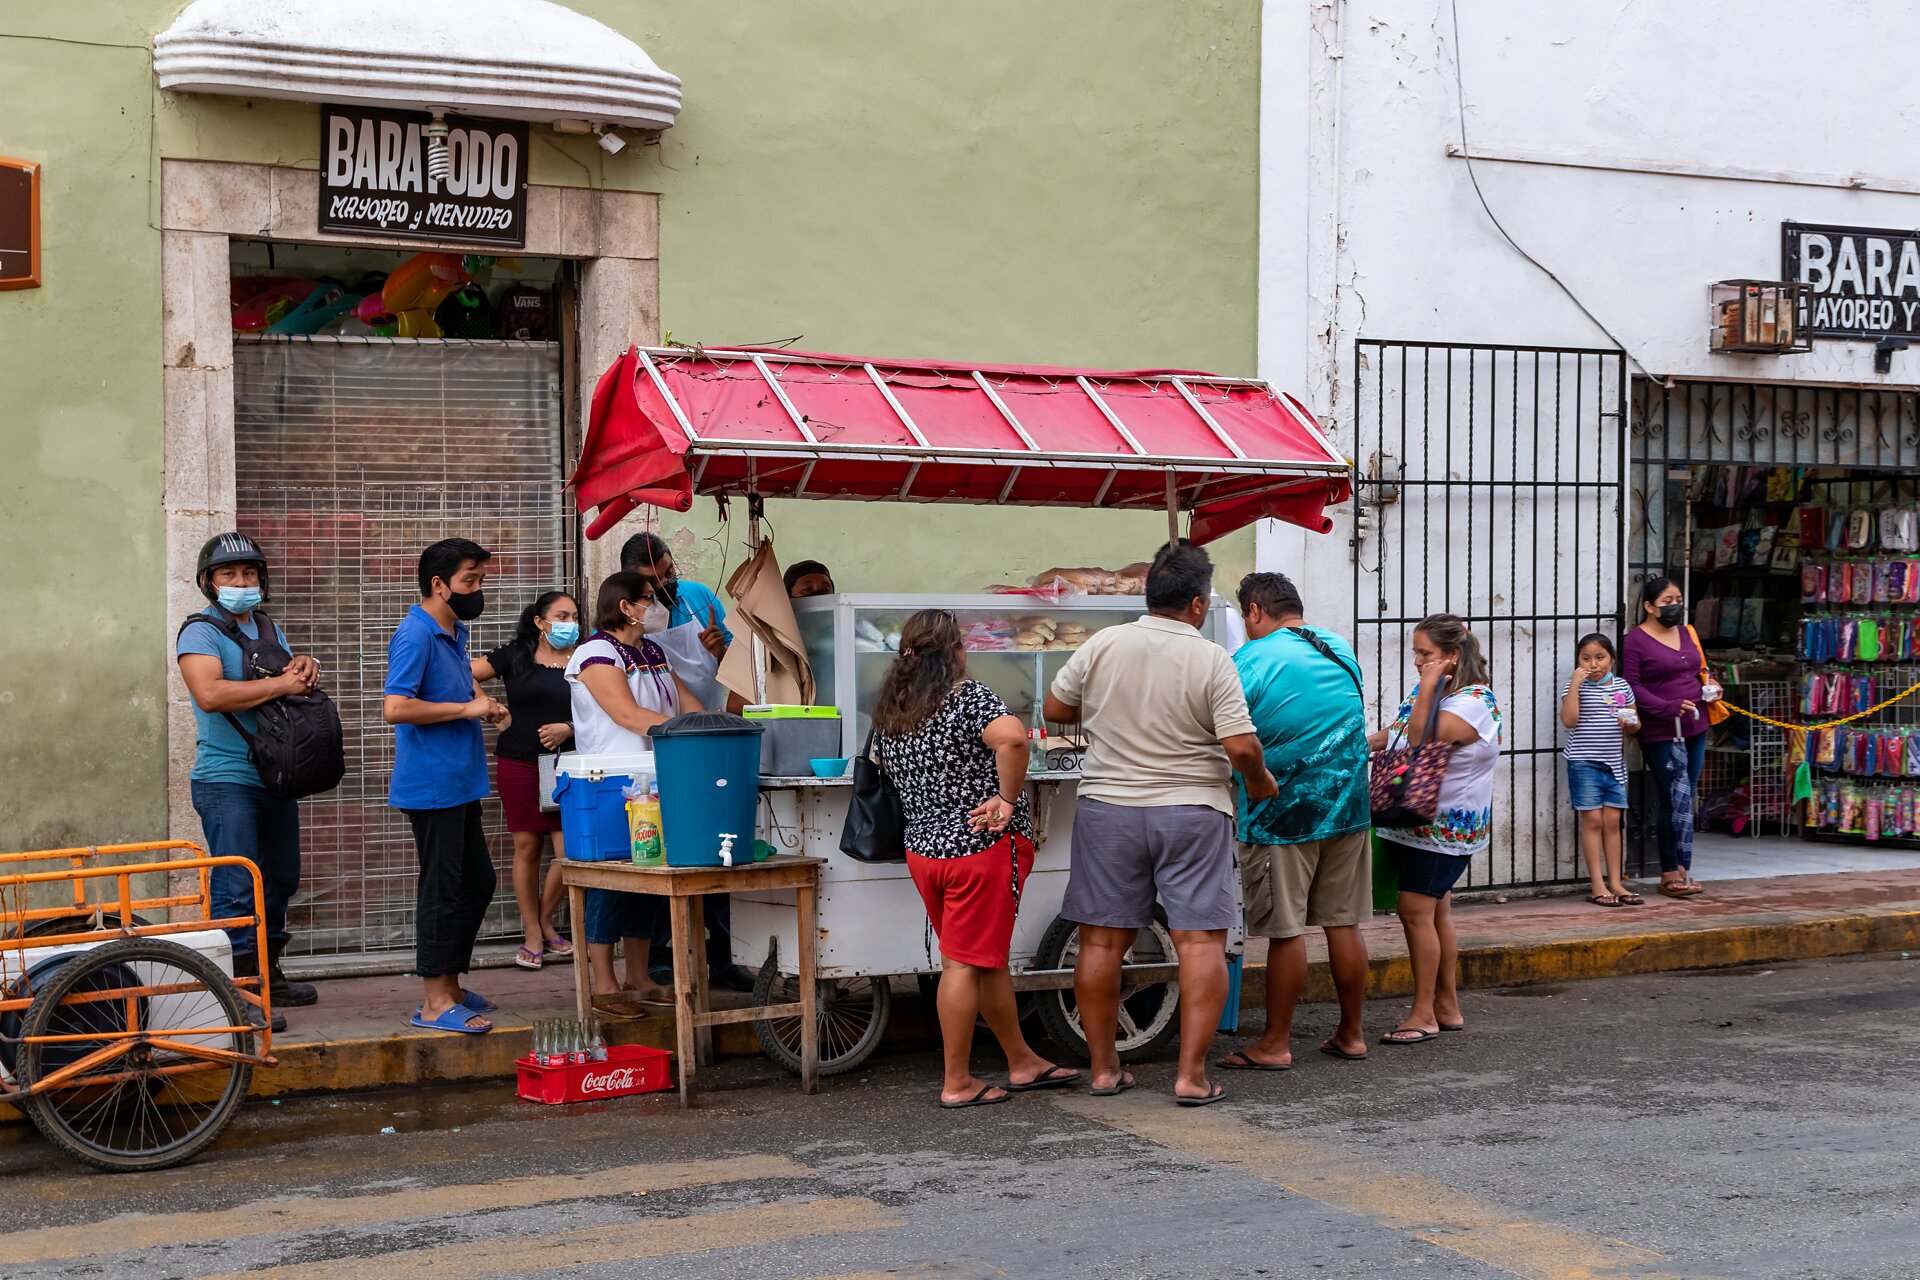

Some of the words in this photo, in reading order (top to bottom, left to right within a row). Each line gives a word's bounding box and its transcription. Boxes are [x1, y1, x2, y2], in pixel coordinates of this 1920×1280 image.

[329, 195, 409, 228] MAYOREO
[425, 202, 513, 230] MENUDEO
[1800, 233, 1920, 296] BARA
[513, 295, 541, 308] VANS
[1902, 301, 1918, 331] Y
[637, 829, 656, 841] AXION
[581, 1068, 634, 1093] Coca-Cola
